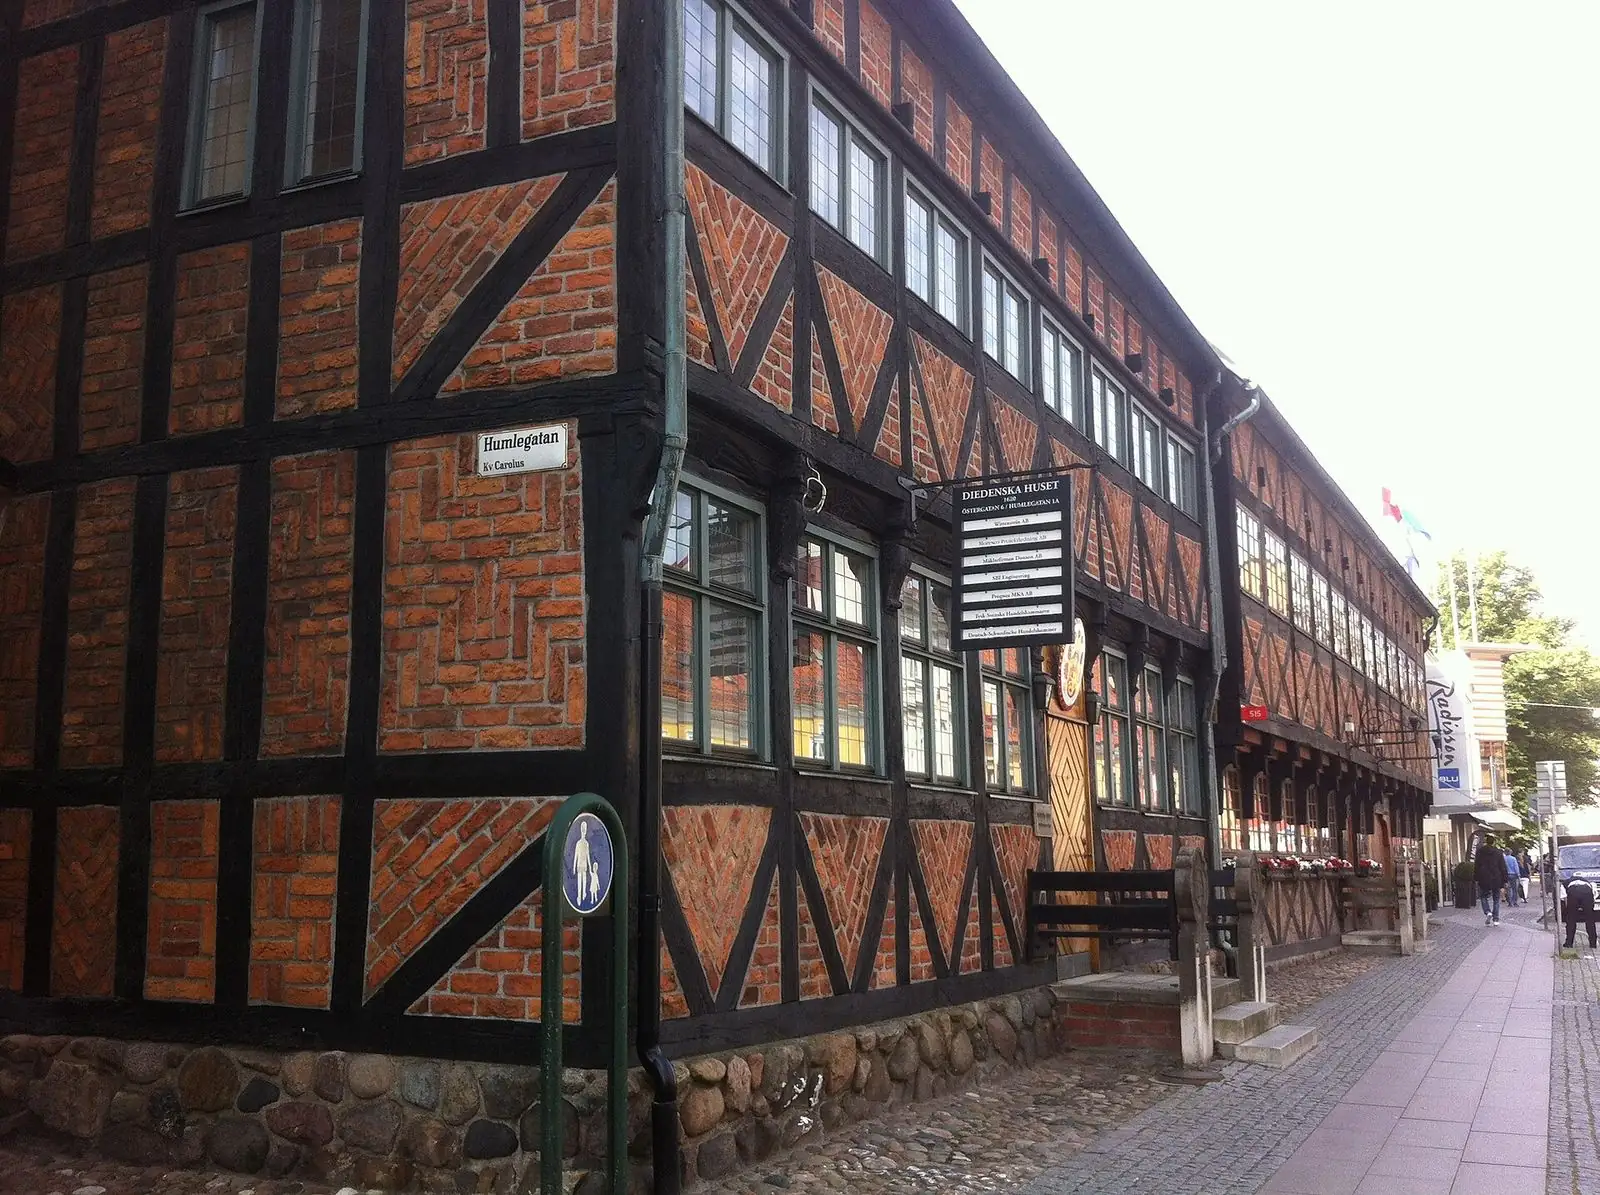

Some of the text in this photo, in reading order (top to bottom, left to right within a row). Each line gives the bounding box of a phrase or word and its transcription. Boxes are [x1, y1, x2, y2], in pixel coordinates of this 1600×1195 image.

[484, 432, 559, 452] Humlegatan
[483, 459, 524, 472] Kv Carolus
[962, 481, 1059, 500] DIEDENSKA HUSET
[962, 505, 999, 514] ÖSTERGATAN
[1009, 499, 1051, 509] HUMLEGATAN
[1426, 680, 1462, 767] Radisson
